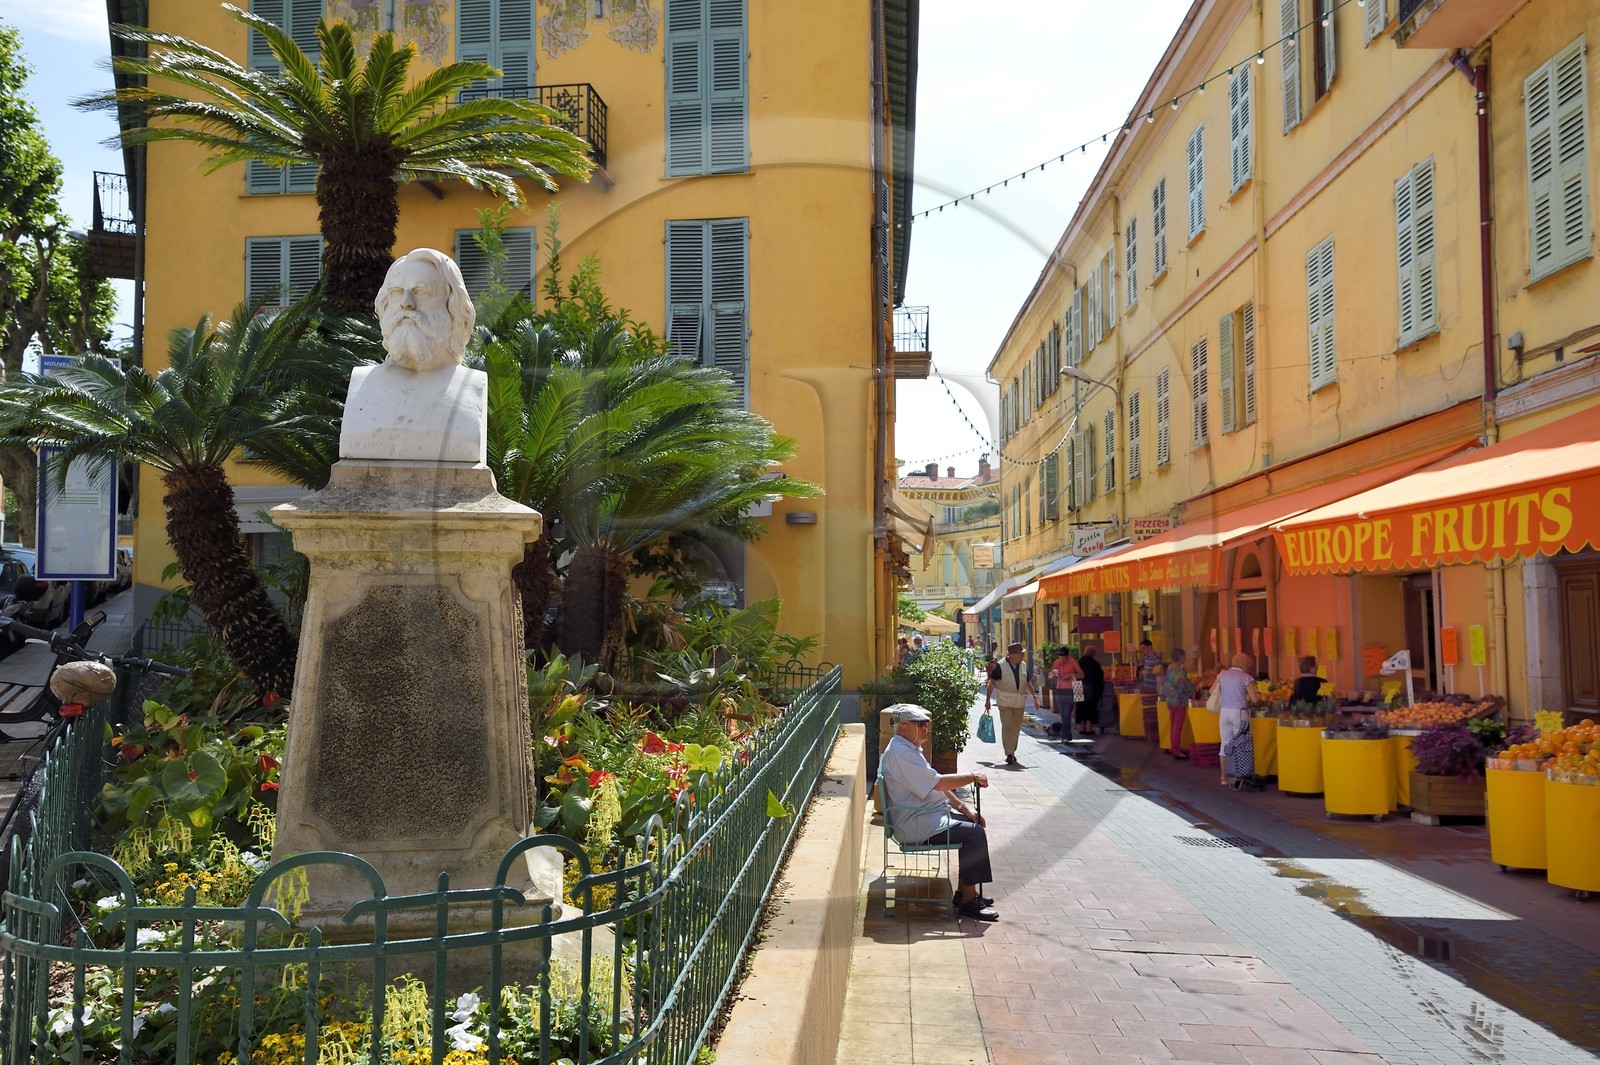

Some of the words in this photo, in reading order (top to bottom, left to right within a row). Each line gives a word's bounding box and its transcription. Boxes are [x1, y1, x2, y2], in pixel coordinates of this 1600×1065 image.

[1133, 519, 1170, 528] PIZZERIA
[1283, 518, 1394, 568] EUROPE
[1411, 486, 1574, 557] FRUITS
[1077, 532, 1101, 549] Little
[1082, 541, 1105, 553] Italy
[1068, 572, 1096, 594] EUROPE
[1100, 567, 1131, 590] FRUITS
